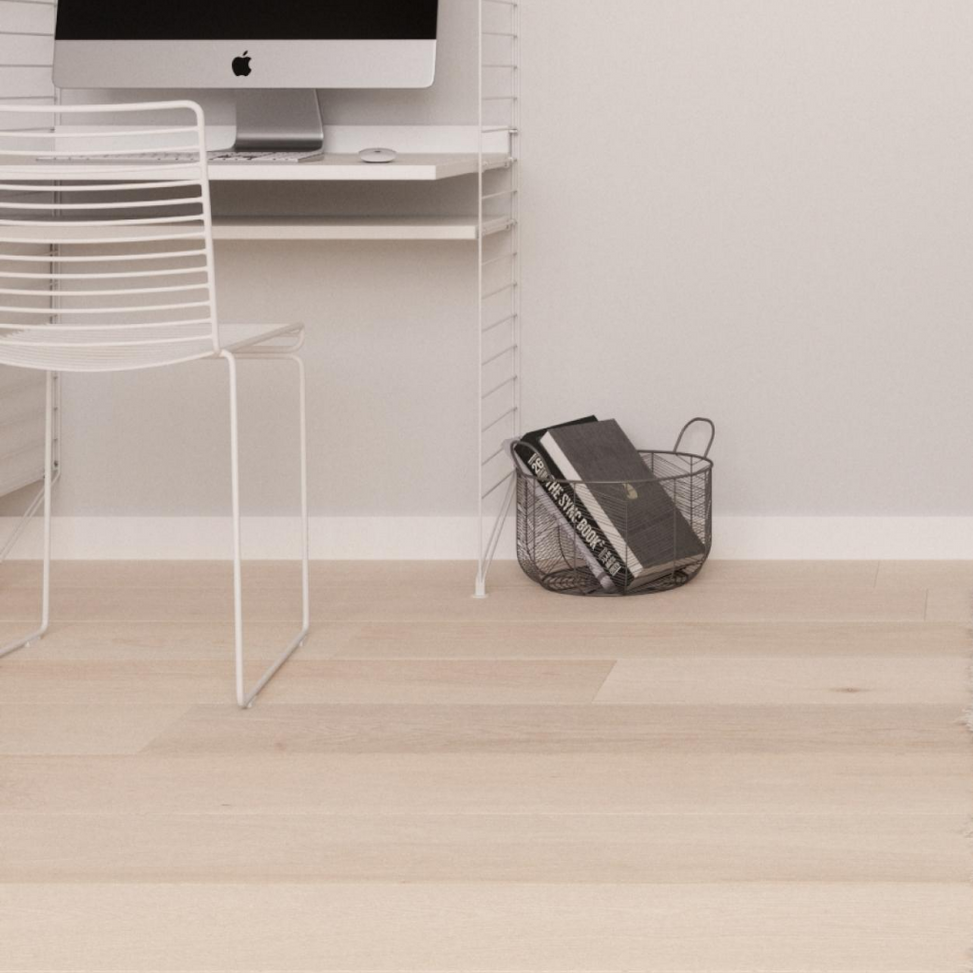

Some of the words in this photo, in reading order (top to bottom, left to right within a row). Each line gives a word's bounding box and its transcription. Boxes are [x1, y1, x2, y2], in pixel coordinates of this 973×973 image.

[531, 457, 545, 475] 26
[545, 475, 564, 500] THE
[558, 493, 582, 523] SYNC
